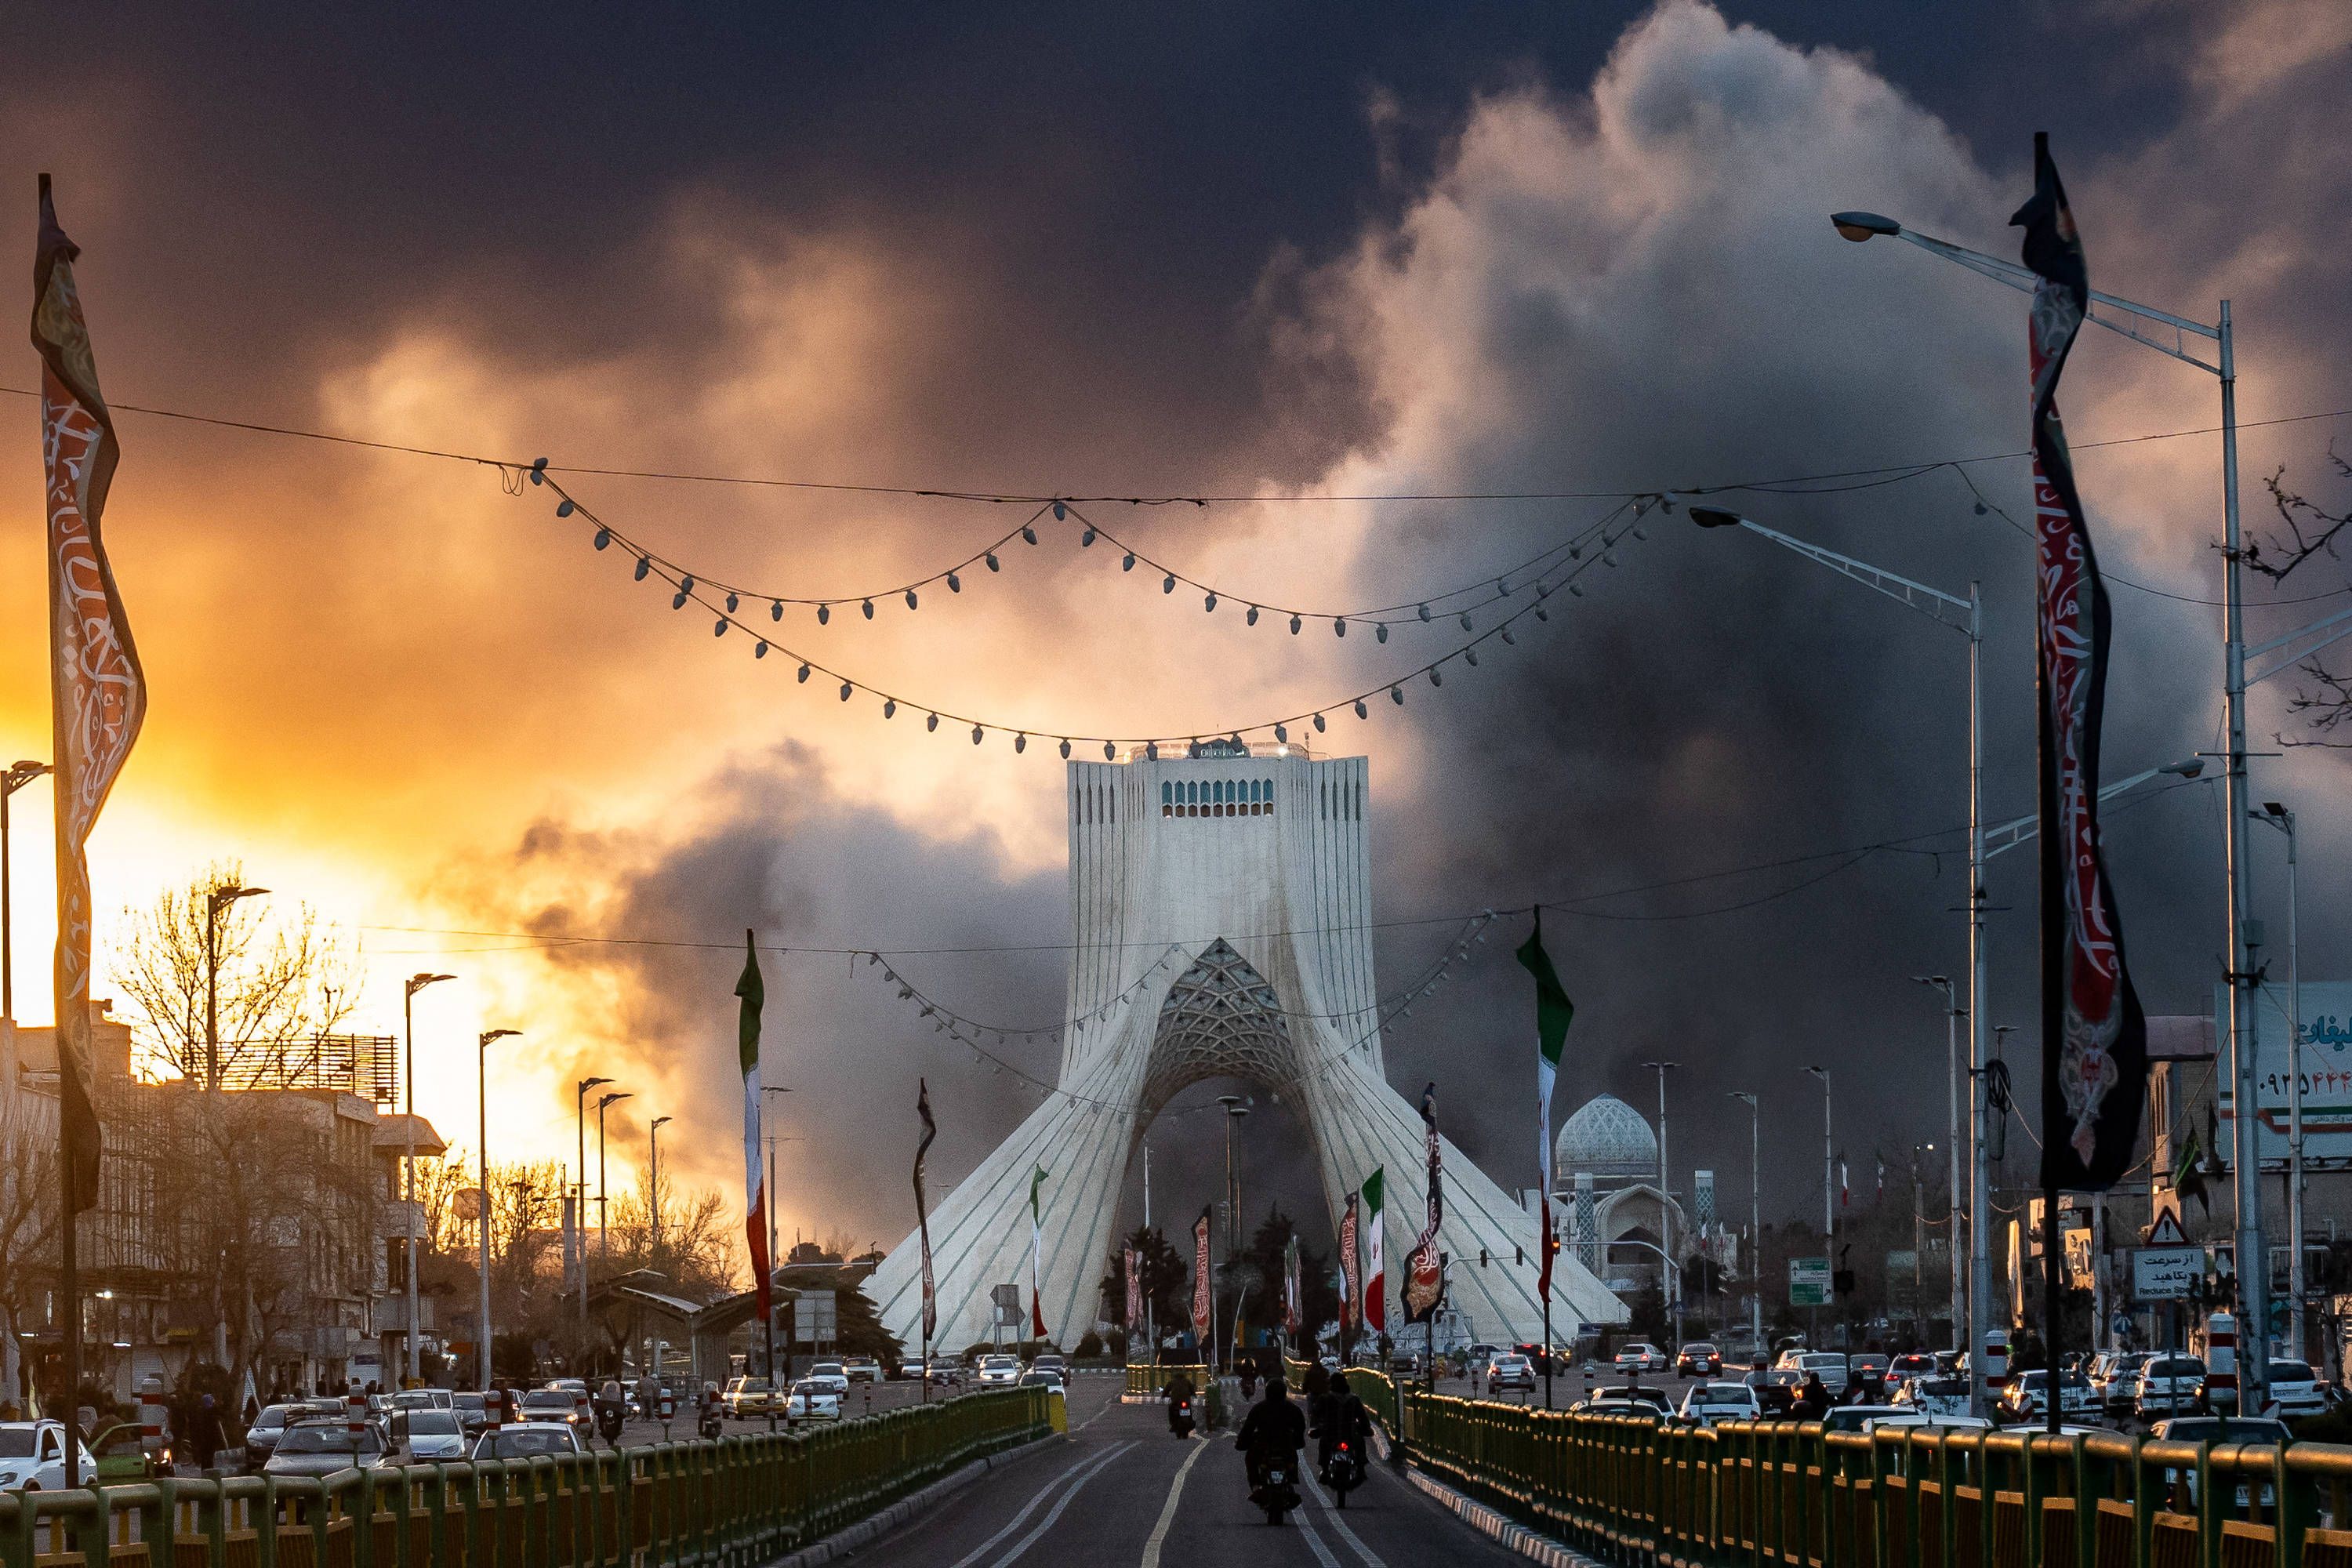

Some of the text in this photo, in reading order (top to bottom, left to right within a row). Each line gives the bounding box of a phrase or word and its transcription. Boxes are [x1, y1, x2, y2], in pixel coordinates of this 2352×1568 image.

[2144, 1254, 2194, 1267] از سرعت
[2151, 1271, 2187, 1283] بکاهید
[2139, 1287, 2172, 1295] Reduce
